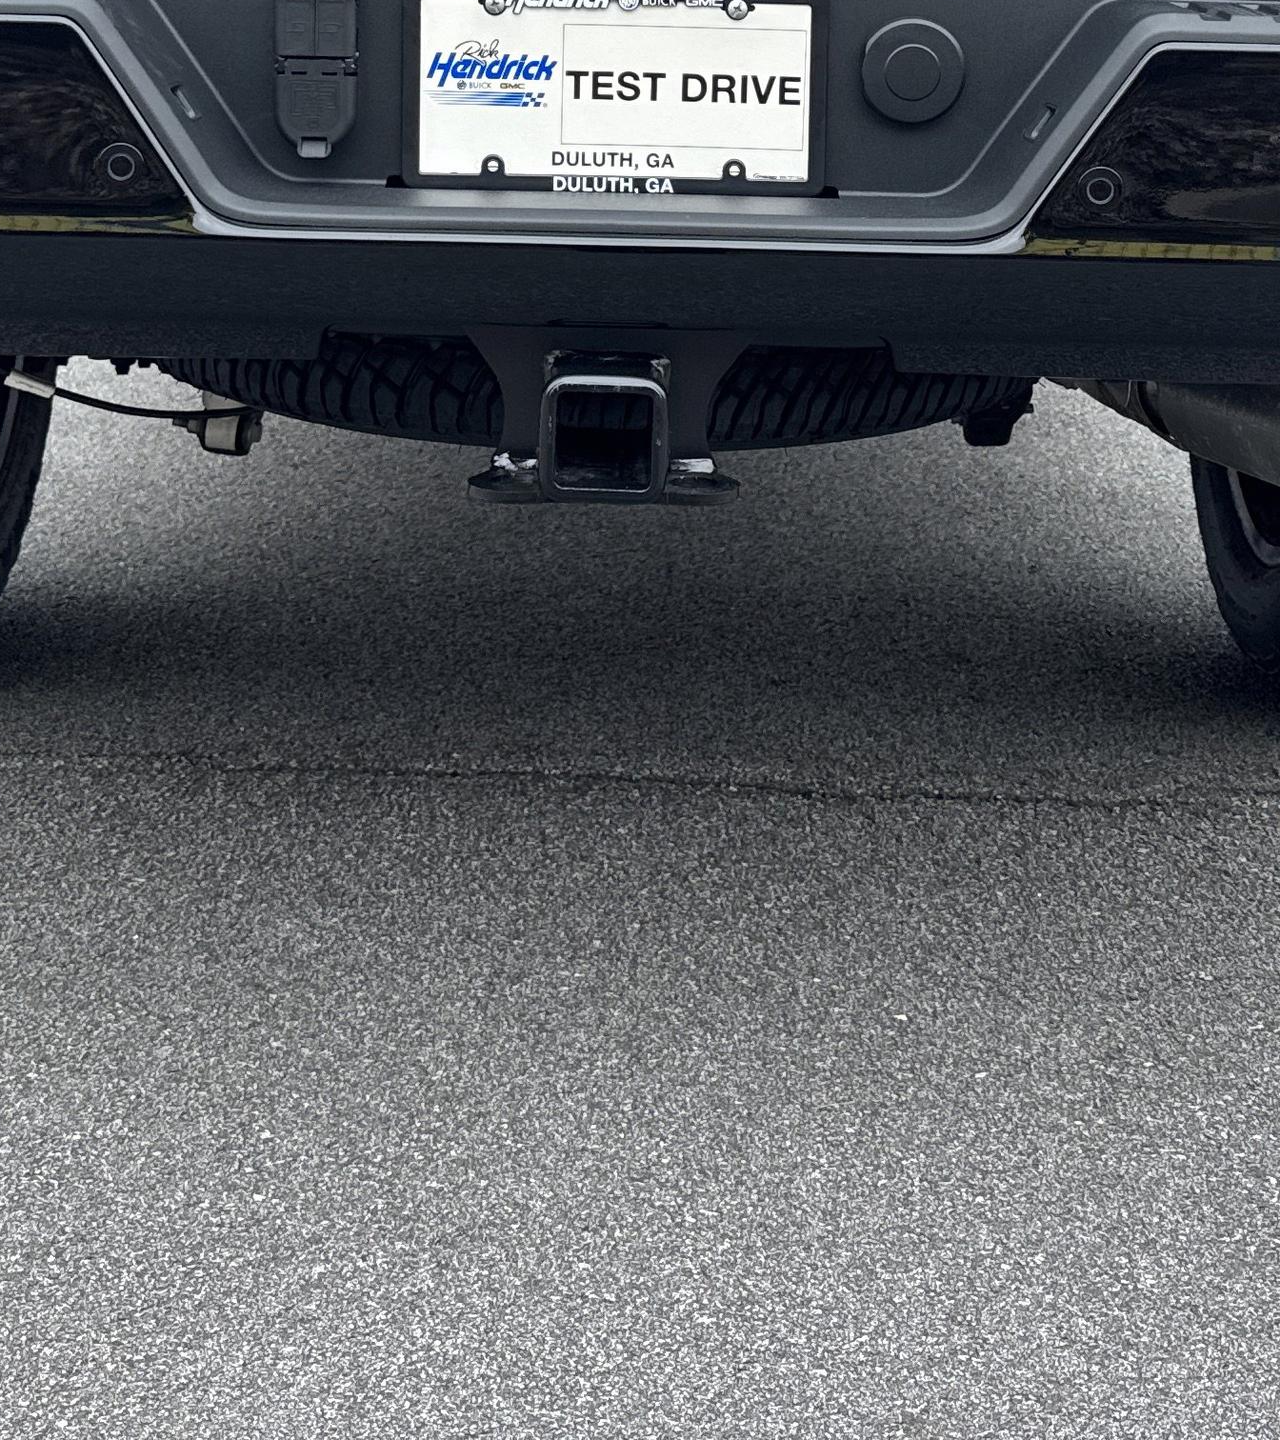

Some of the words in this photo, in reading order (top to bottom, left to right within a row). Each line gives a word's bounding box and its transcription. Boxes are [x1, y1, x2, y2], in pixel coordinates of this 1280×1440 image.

[455, 39, 499, 63] Rick
[426, 52, 557, 88] Hendrick
[469, 82, 491, 90] BUICK
[500, 82, 525, 90] GMC
[566, 70, 666, 102] TEST
[681, 73, 801, 106] DRIVE
[552, 151, 639, 171] DULUTH,
[646, 153, 674, 168] GA
[552, 176, 639, 194] DULUTH,
[645, 178, 674, 194] GA
